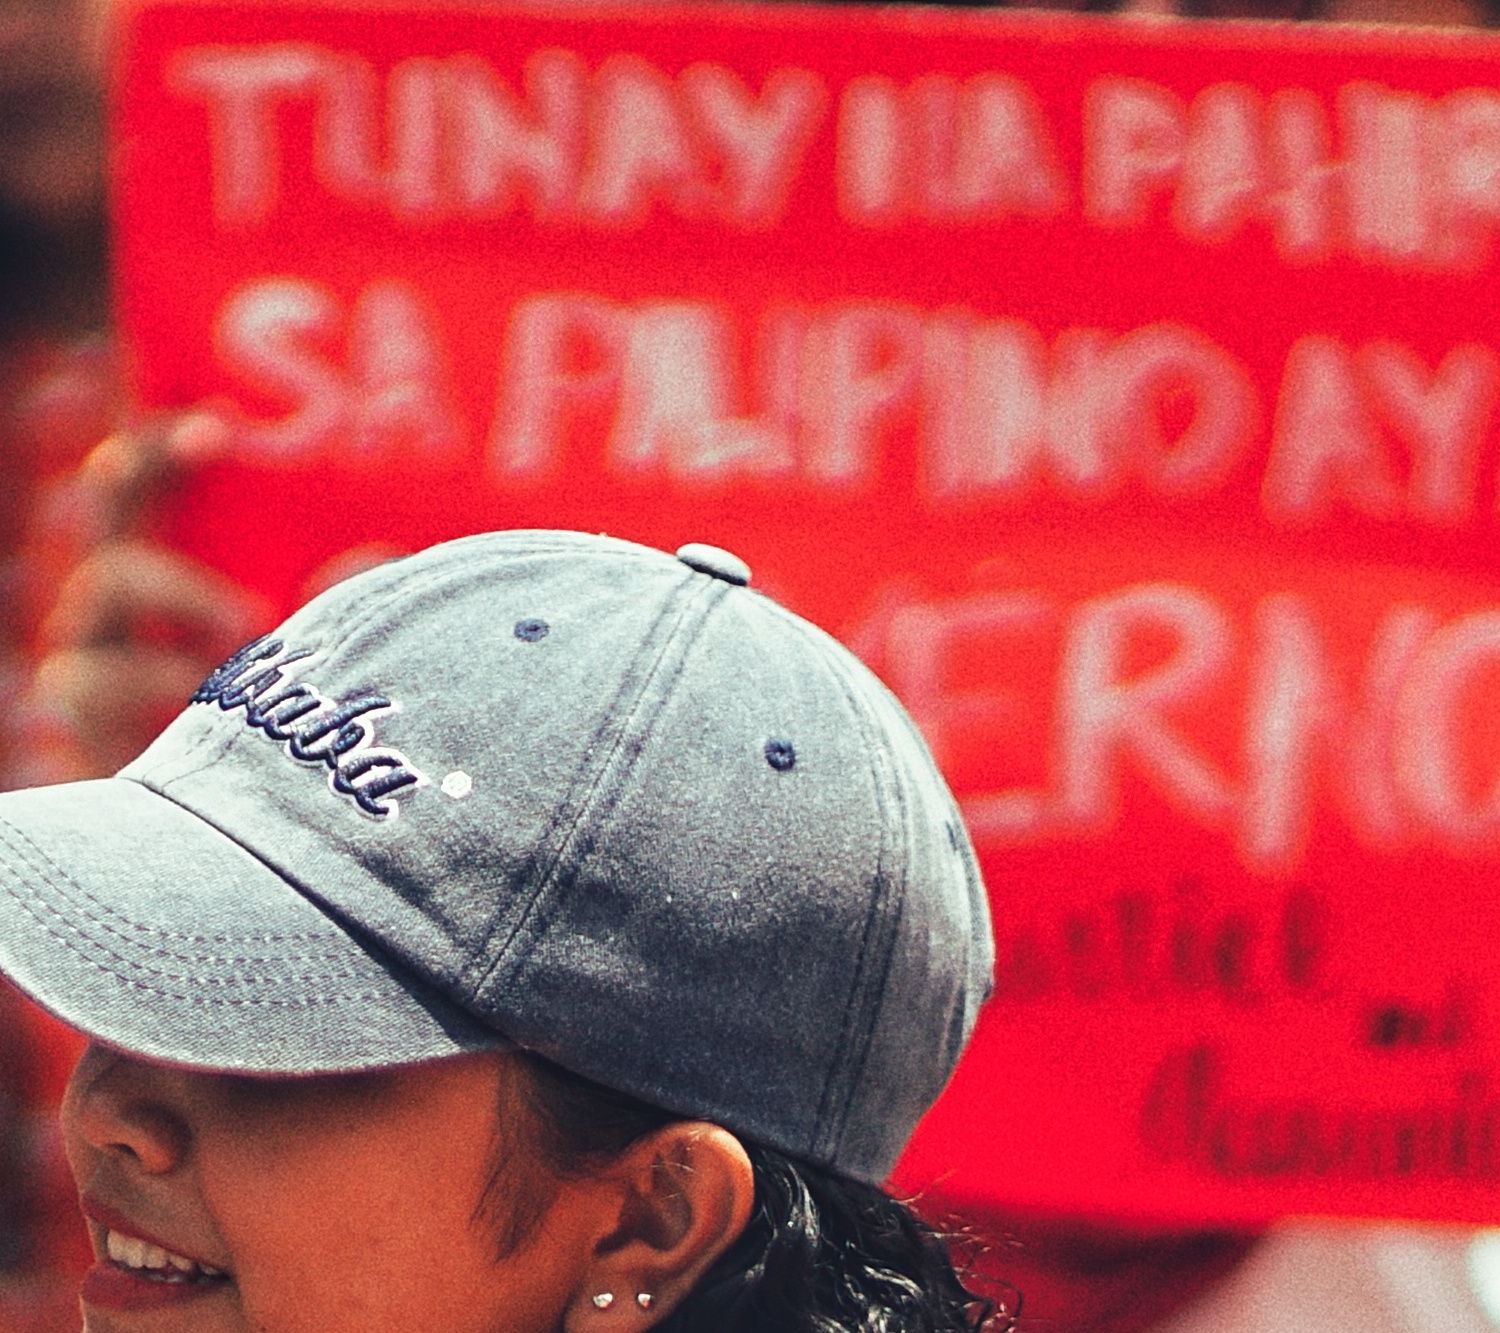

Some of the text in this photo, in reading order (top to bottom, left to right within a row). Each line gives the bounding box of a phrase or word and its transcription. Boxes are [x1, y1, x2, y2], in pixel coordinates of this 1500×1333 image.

[166, 42, 822, 230] TUNAY
[836, 68, 1070, 228] NA
[214, 272, 464, 466] SA
[488, 286, 1258, 496] PILIPINO
[1262, 330, 1498, 528] AY
